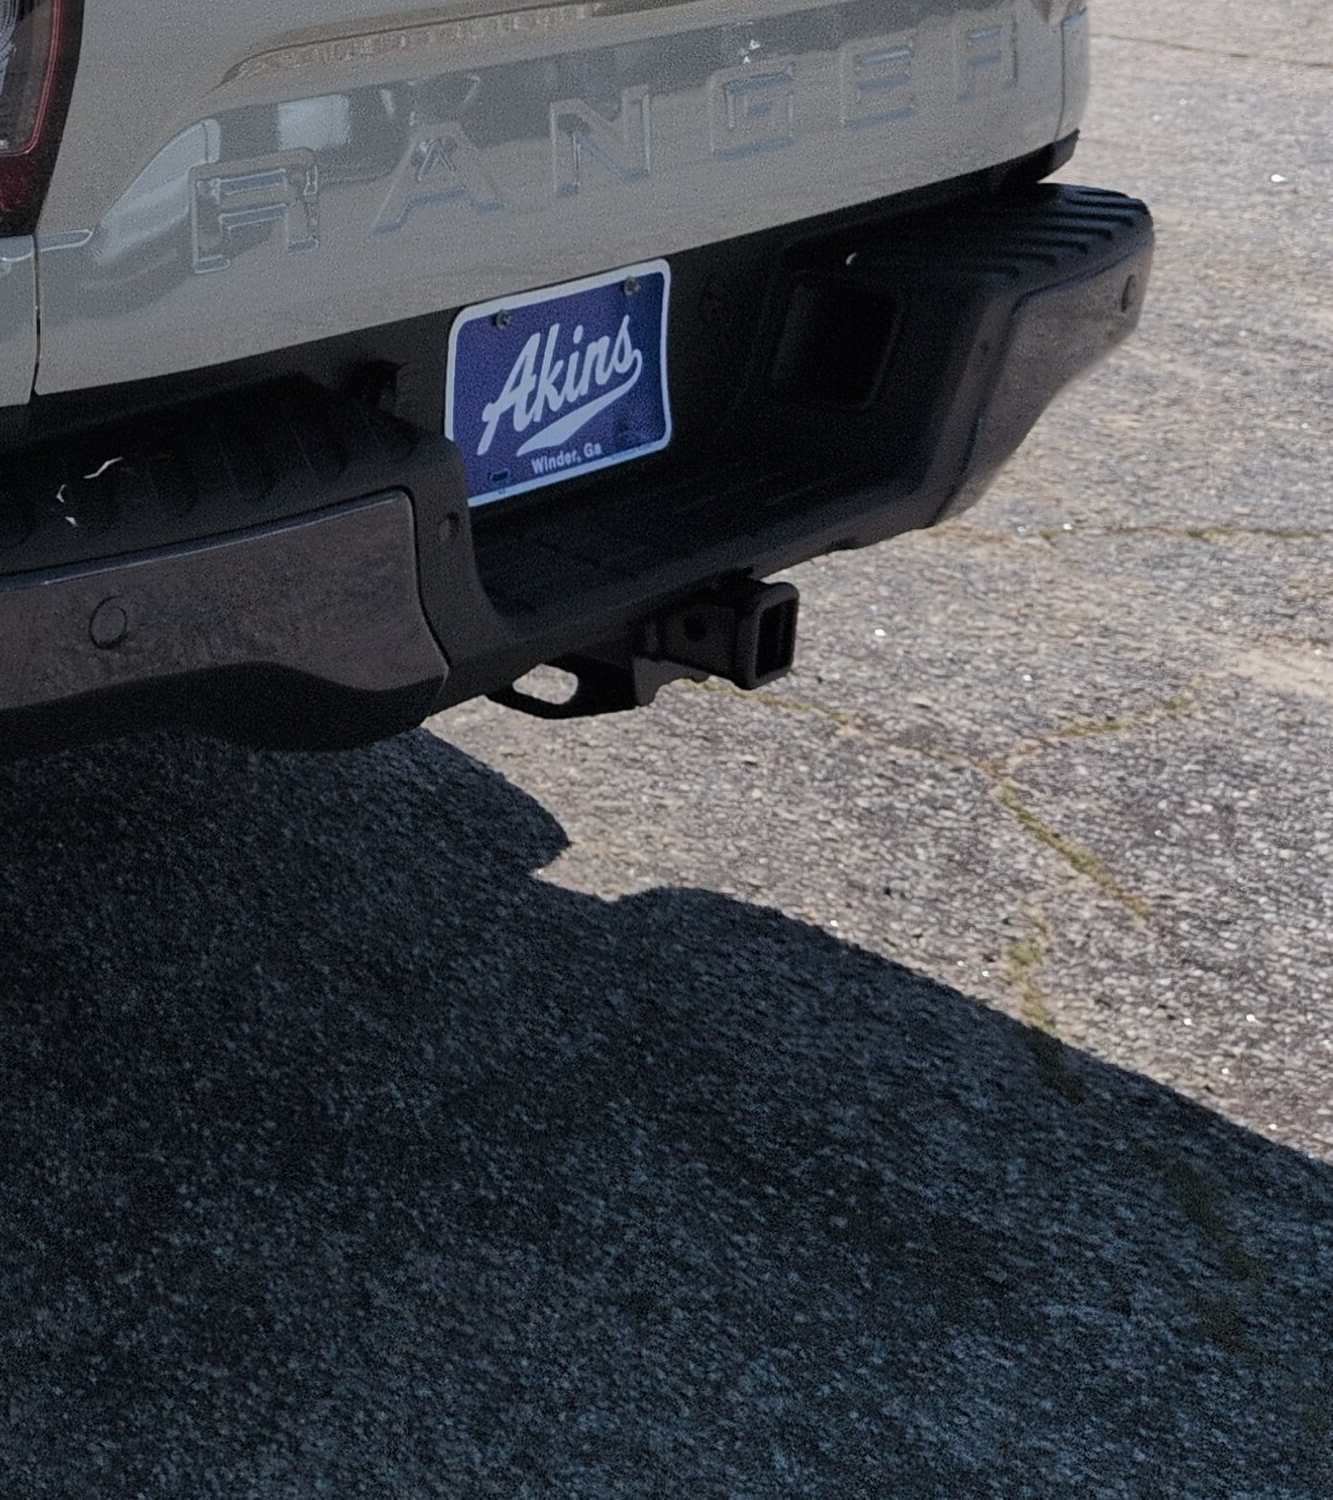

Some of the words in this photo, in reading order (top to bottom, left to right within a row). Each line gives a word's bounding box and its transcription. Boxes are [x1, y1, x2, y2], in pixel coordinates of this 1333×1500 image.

[190, 12, 1020, 274] RANGER
[476, 314, 643, 457] Akins
[583, 441, 602, 457] Ga
